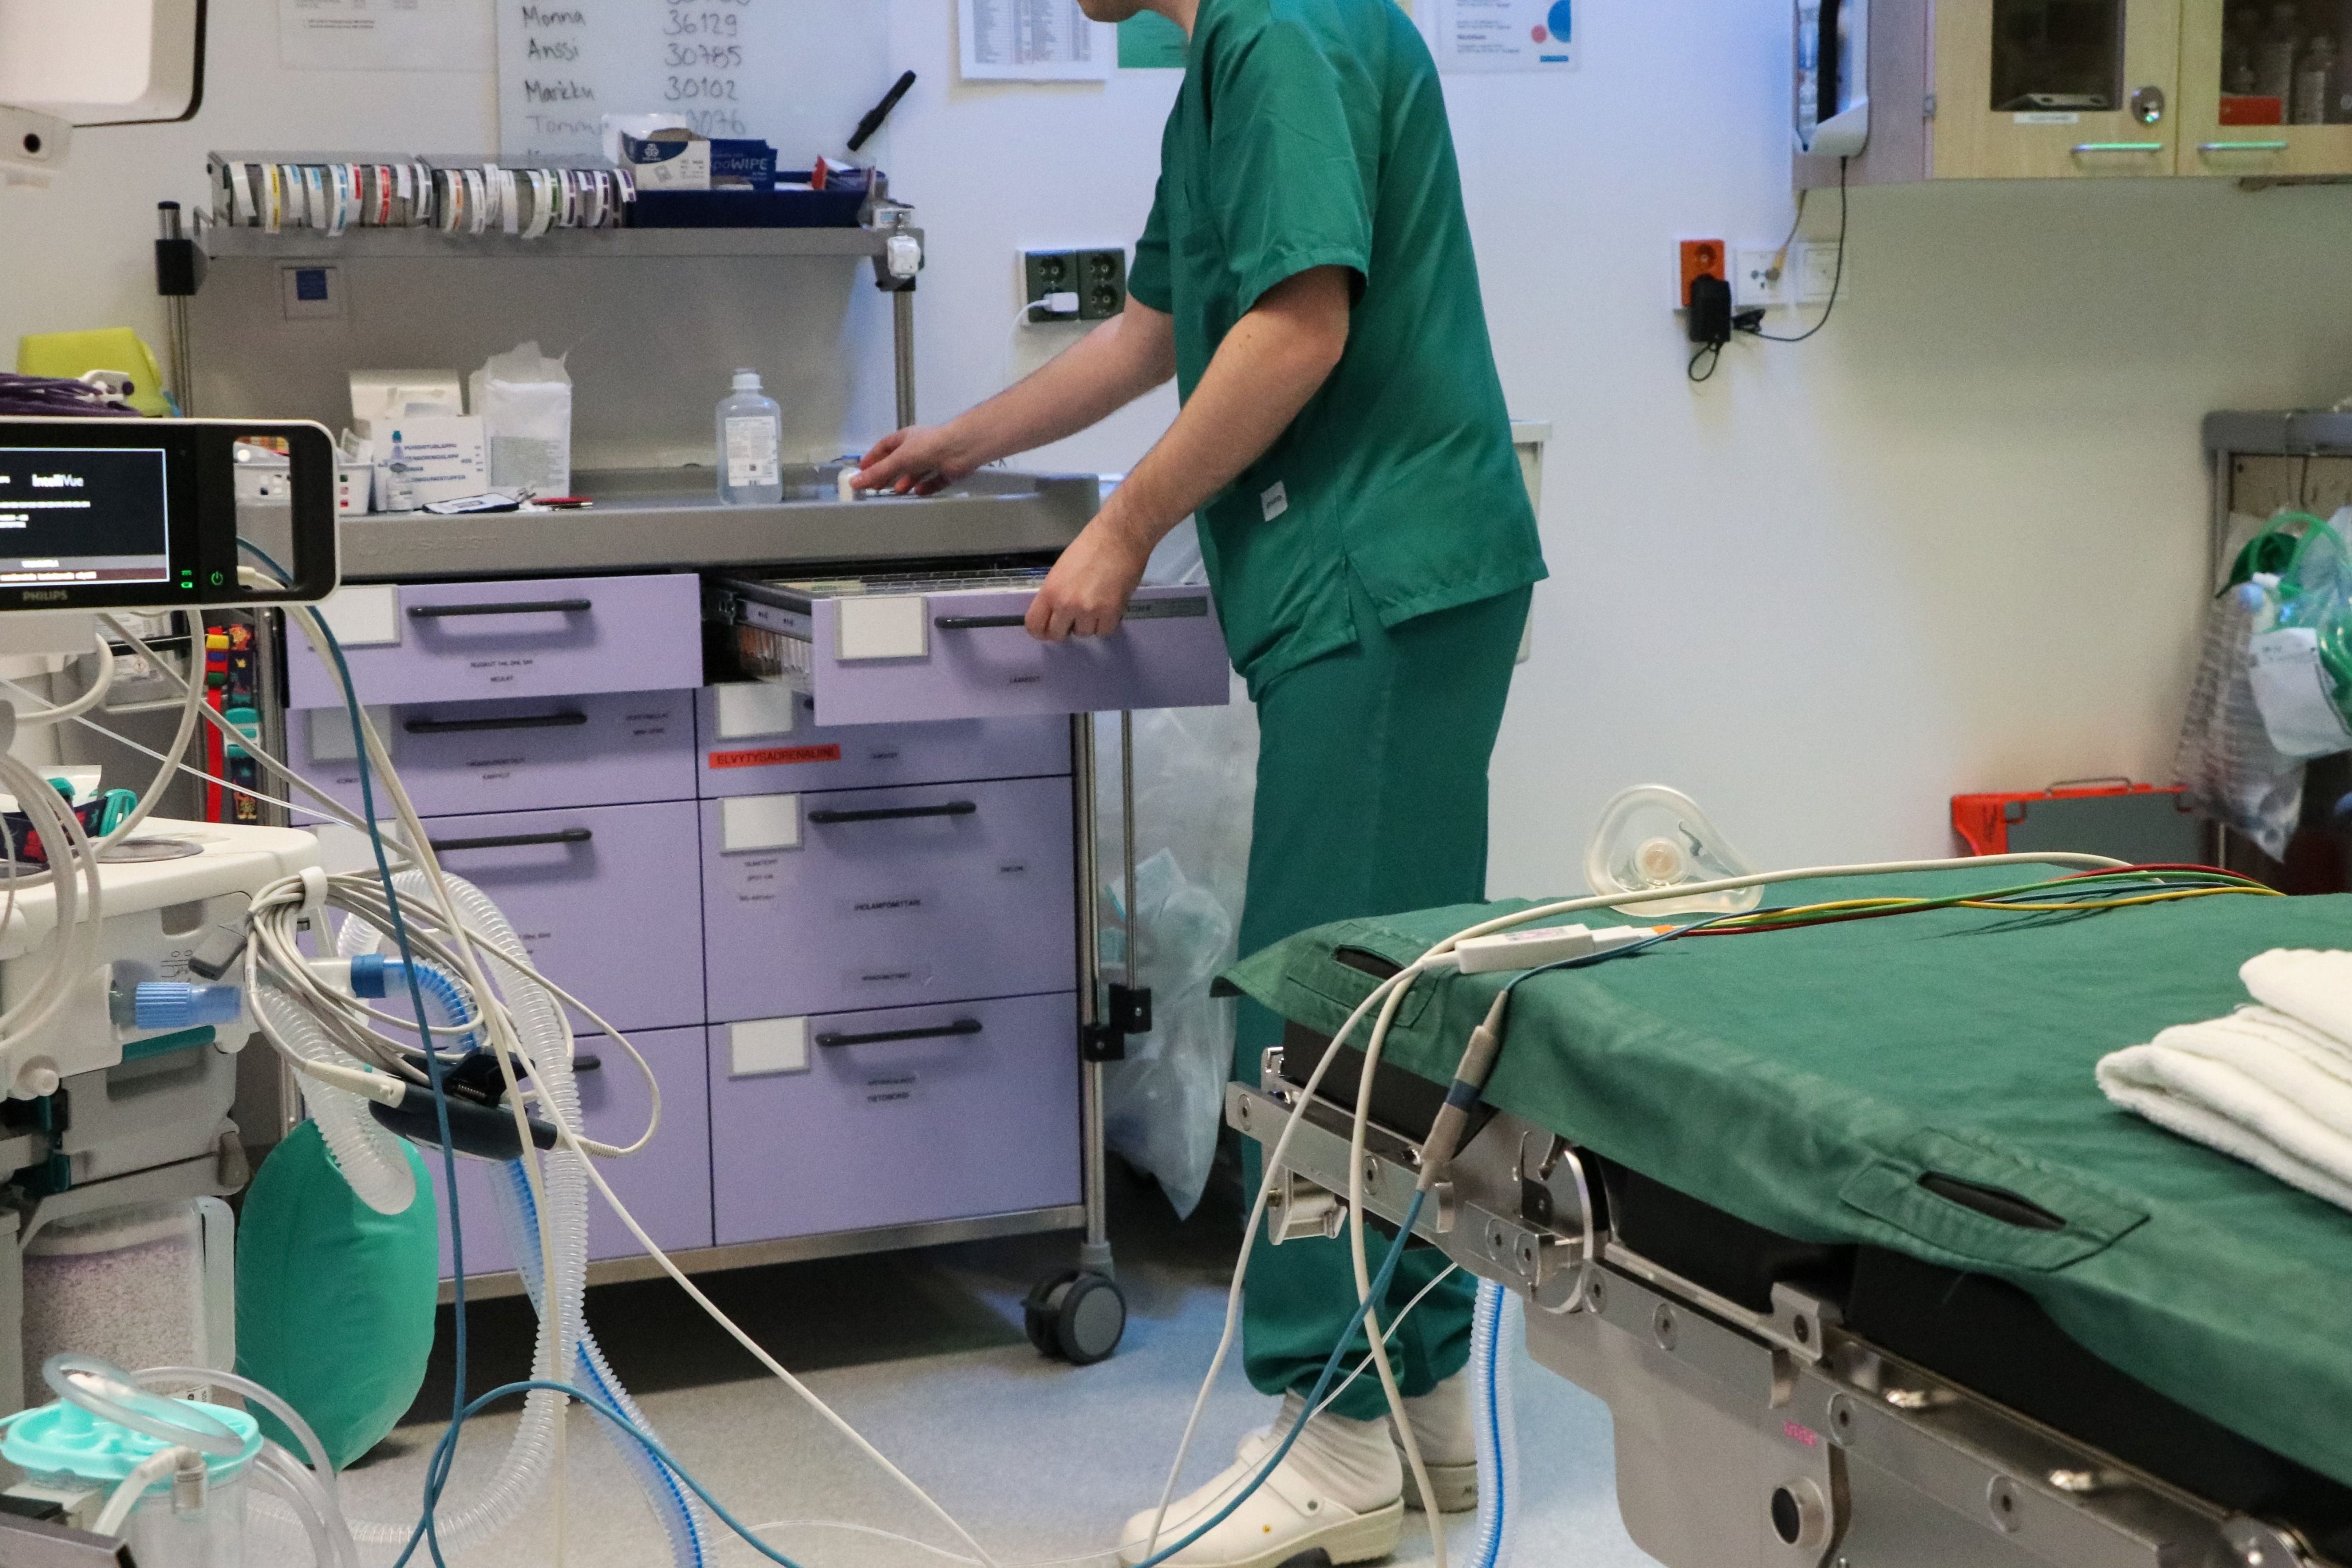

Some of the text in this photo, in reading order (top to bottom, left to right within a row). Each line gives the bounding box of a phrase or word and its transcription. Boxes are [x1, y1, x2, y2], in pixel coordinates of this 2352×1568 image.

[663, 9, 737, 37] 36129
[528, 37, 579, 61] Anssi
[664, 43, 742, 69] 30785
[664, 76, 739, 101] 30102
[23, 590, 68, 601] PHILIPS
[717, 748, 834, 765] ELVYTYSADRENALIINI
